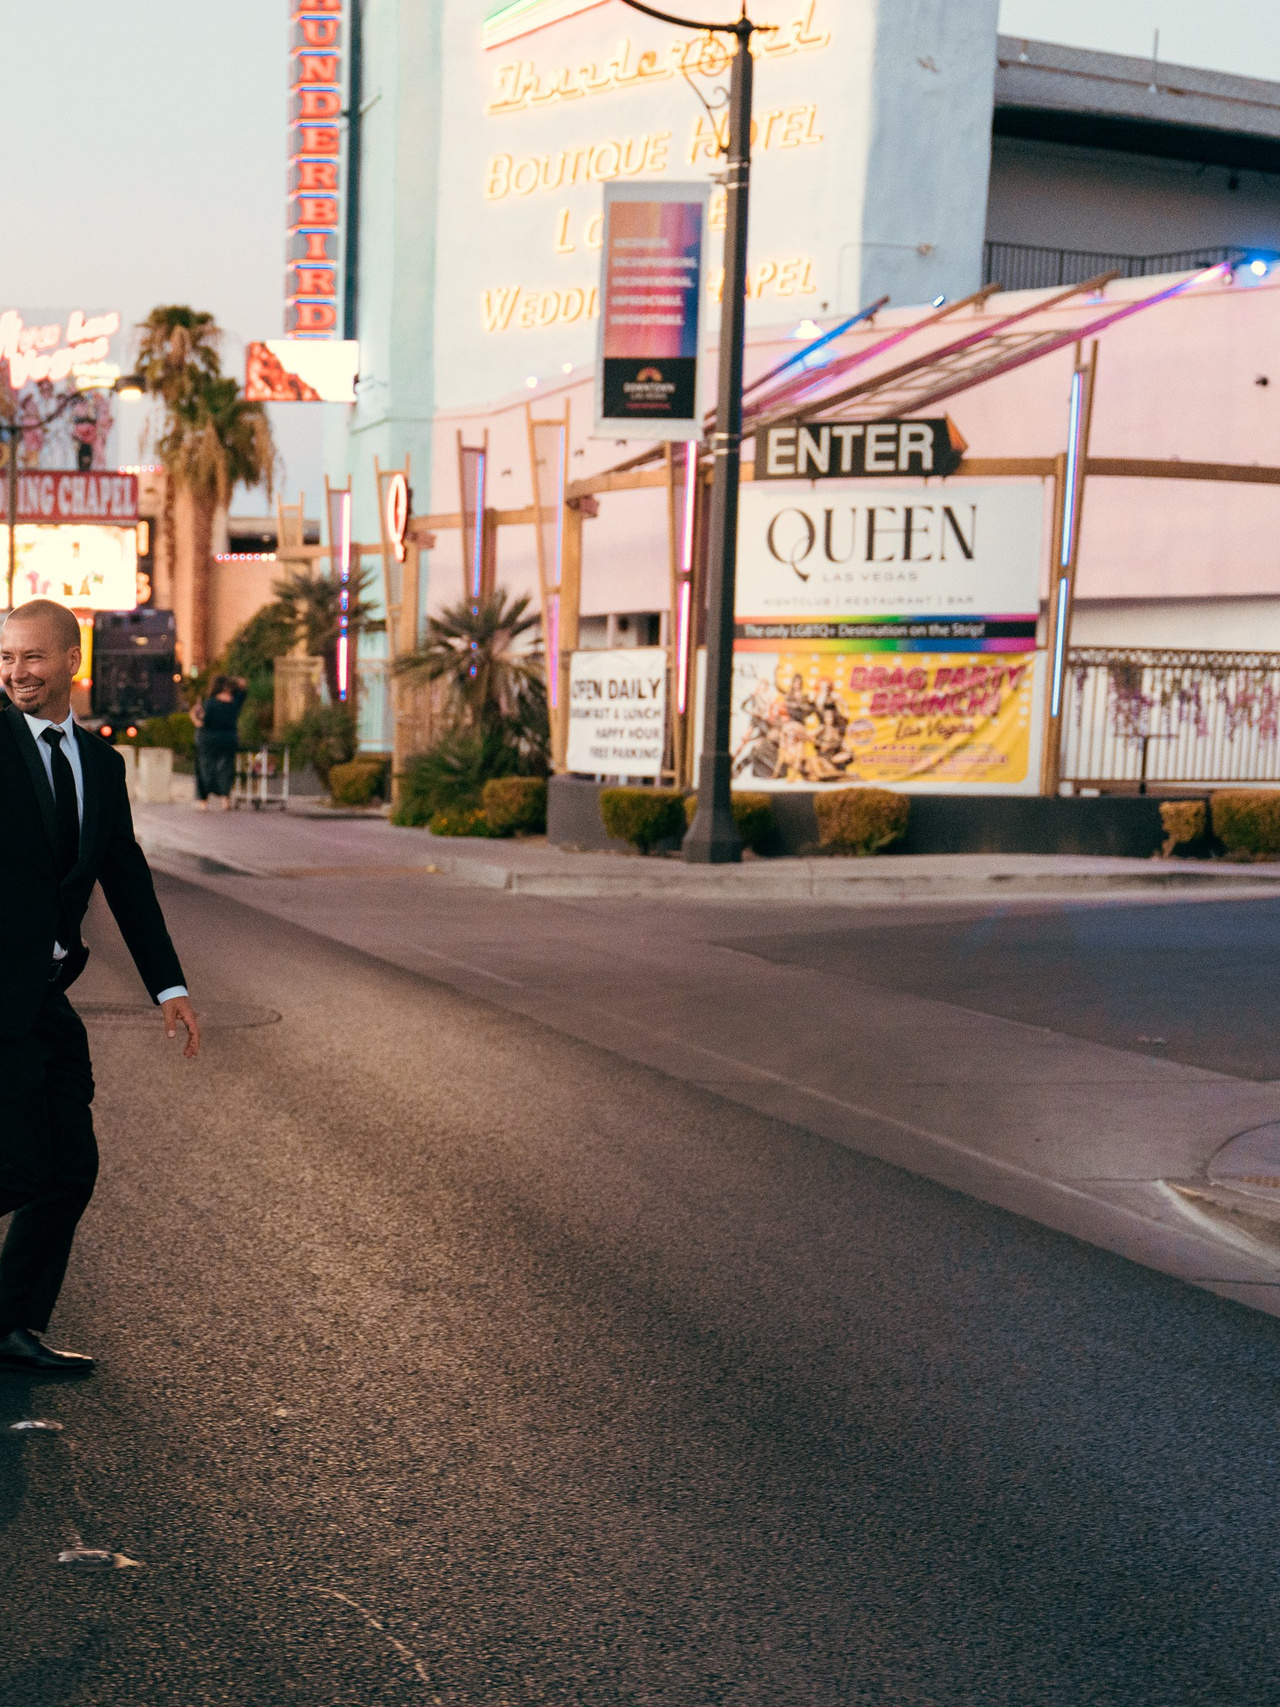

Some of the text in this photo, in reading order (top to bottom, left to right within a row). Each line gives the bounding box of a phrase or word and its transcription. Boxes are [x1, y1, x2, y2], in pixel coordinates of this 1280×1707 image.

[483, 131, 672, 200] BOUTIQUE
[765, 422, 935, 475] ENTER
[57, 475, 133, 517] CHAPEL
[765, 504, 978, 582] QUEEN
[822, 570, 918, 583] LAS VEGAS
[843, 595, 932, 606] RESTAURANT
[947, 595, 974, 605] BAR
[744, 624, 764, 637] The
[765, 624, 790, 639] only
[838, 623, 908, 638] Destination
[909, 625, 928, 637] on
[927, 624, 951, 637] the
[608, 678, 661, 699] DAILY
[850, 665, 1028, 690] DRAG PARTY
[629, 727, 660, 739] HOUR
